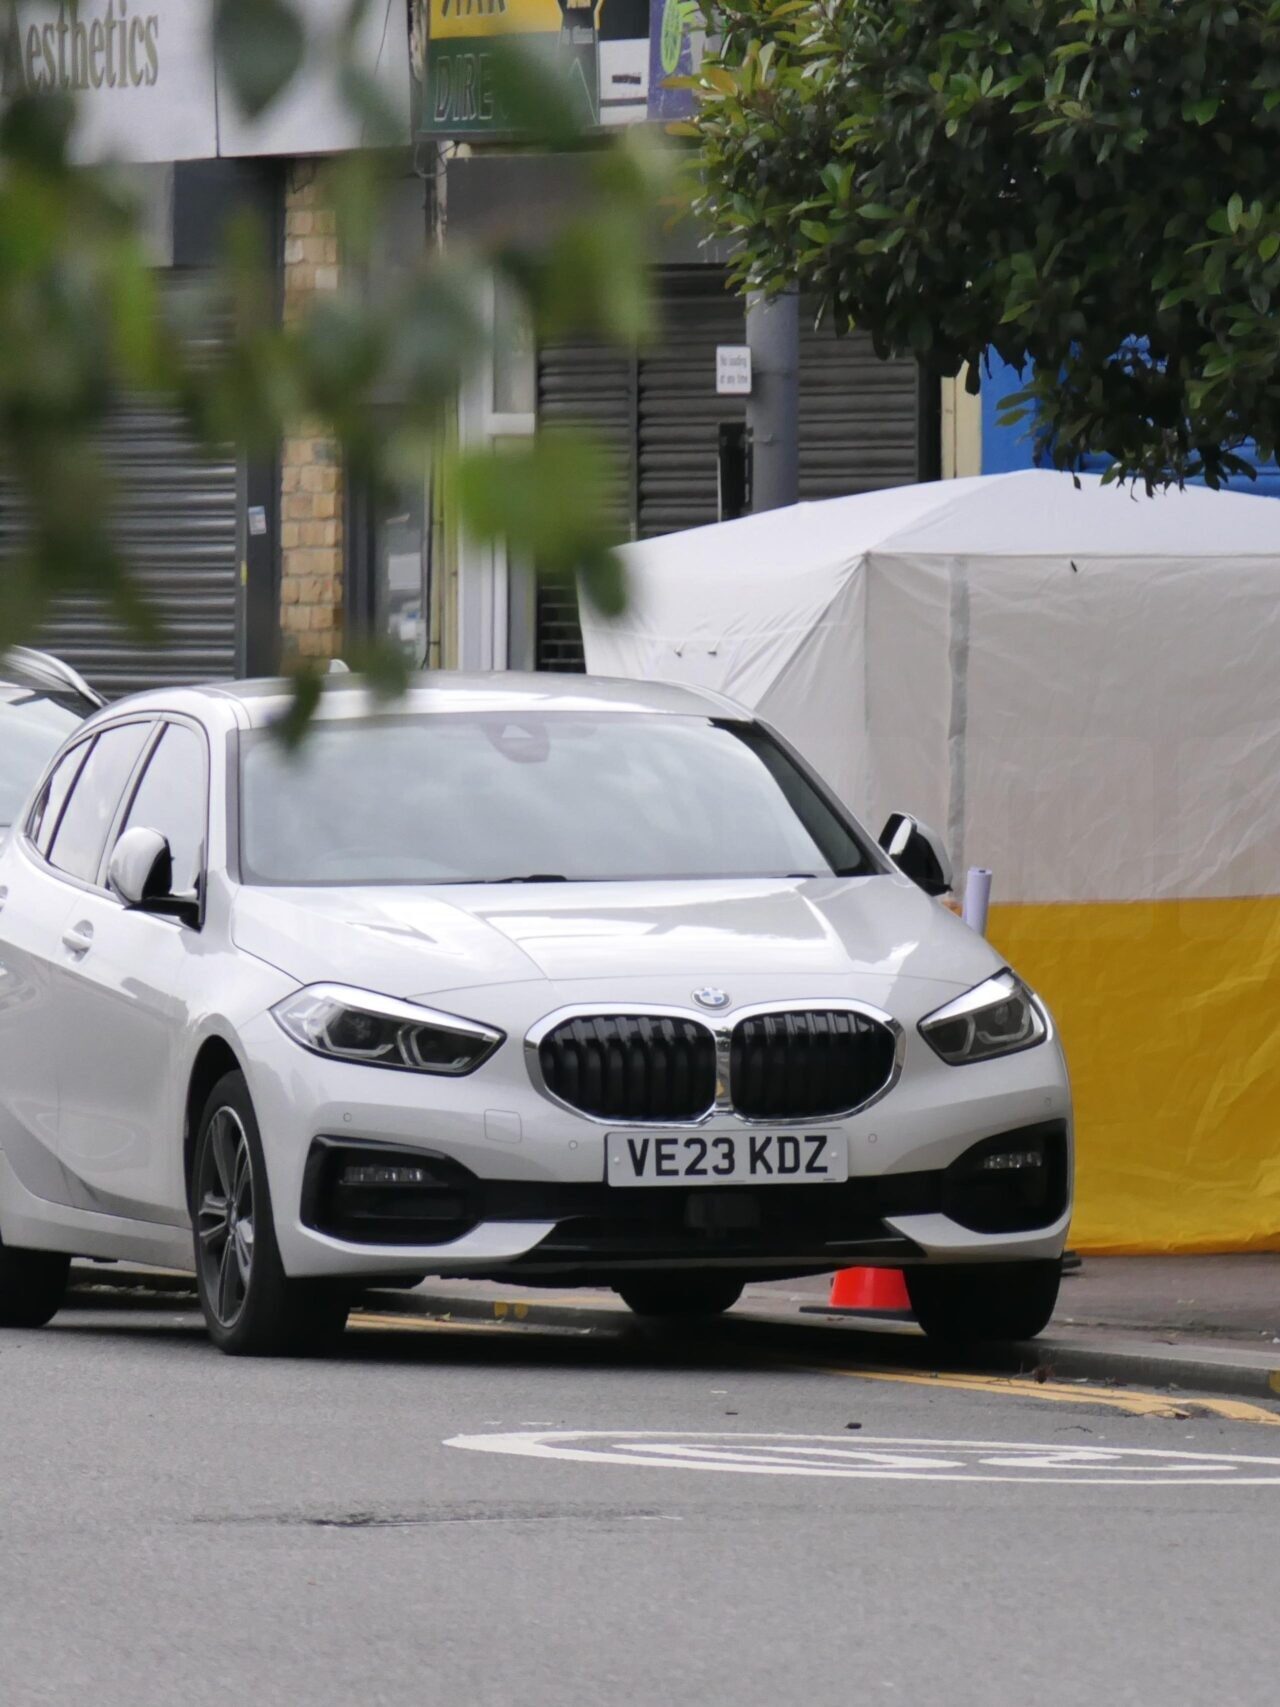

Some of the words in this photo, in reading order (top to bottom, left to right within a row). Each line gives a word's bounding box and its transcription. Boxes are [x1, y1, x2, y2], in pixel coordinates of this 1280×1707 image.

[4, 0, 159, 91] esthetics
[433, 53, 508, 122] DIRE
[628, 1137, 735, 1177] VE23
[750, 1135, 828, 1174] KDZ
